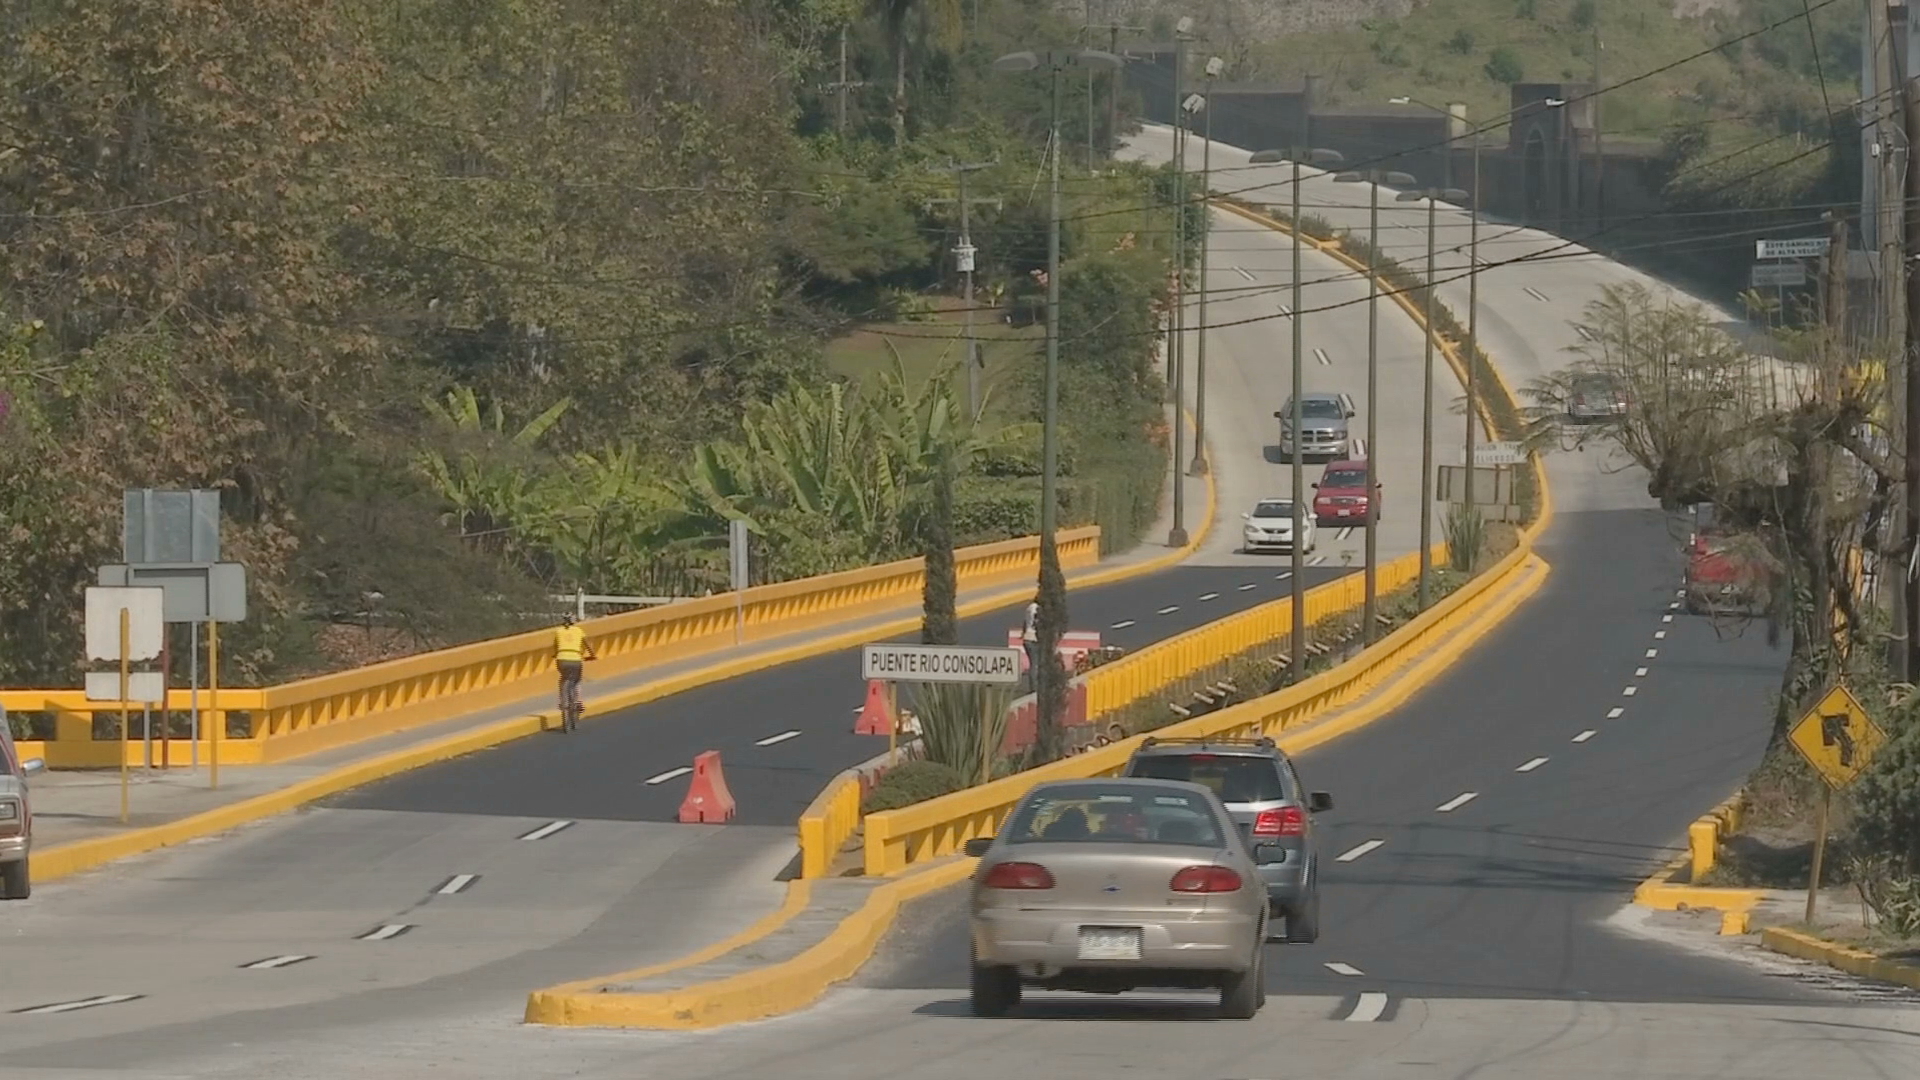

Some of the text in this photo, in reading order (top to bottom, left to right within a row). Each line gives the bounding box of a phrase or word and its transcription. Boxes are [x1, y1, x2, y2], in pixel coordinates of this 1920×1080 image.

[871, 652, 1014, 675] PUENTE RIO CONSOLAPA
